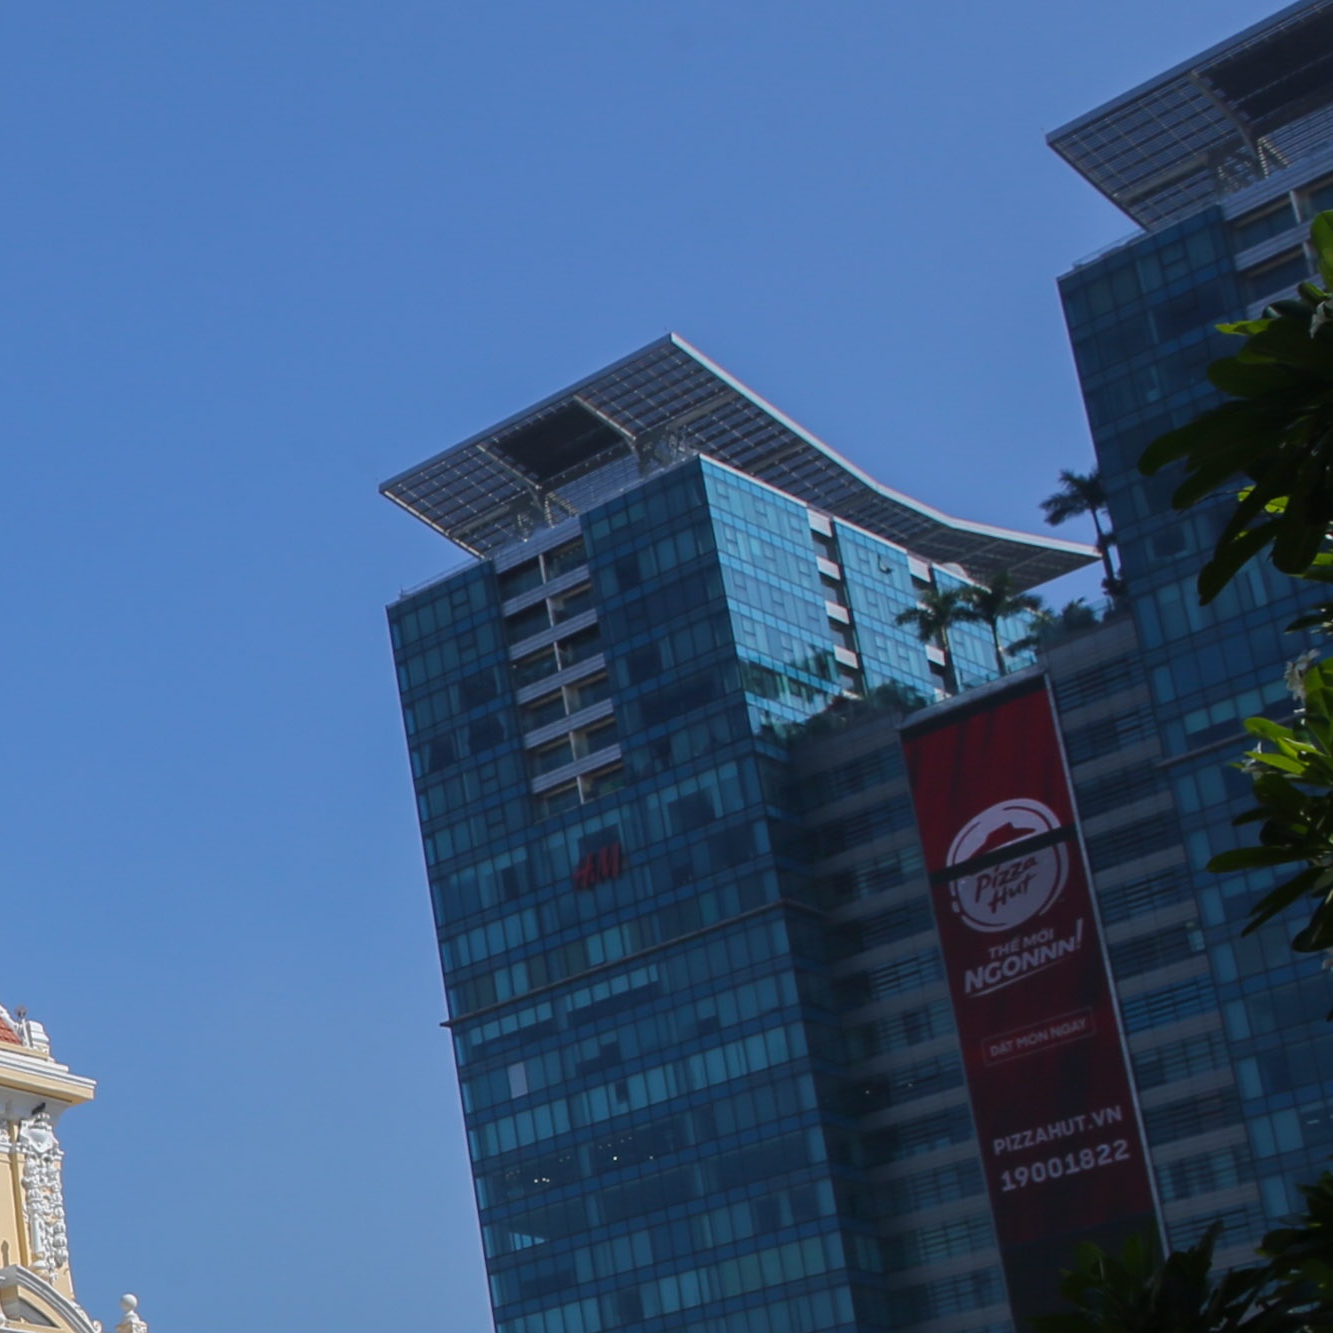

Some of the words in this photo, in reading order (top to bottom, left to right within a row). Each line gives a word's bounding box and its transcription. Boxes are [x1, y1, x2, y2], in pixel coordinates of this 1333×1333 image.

[974, 857, 1038, 904] Pizza
[987, 872, 1037, 915] Hut
[964, 917, 1084, 994] NGONNN!
[992, 1104, 1124, 1156] PIZZAHUT.VN
[1000, 1138, 1130, 1192] 19001822
